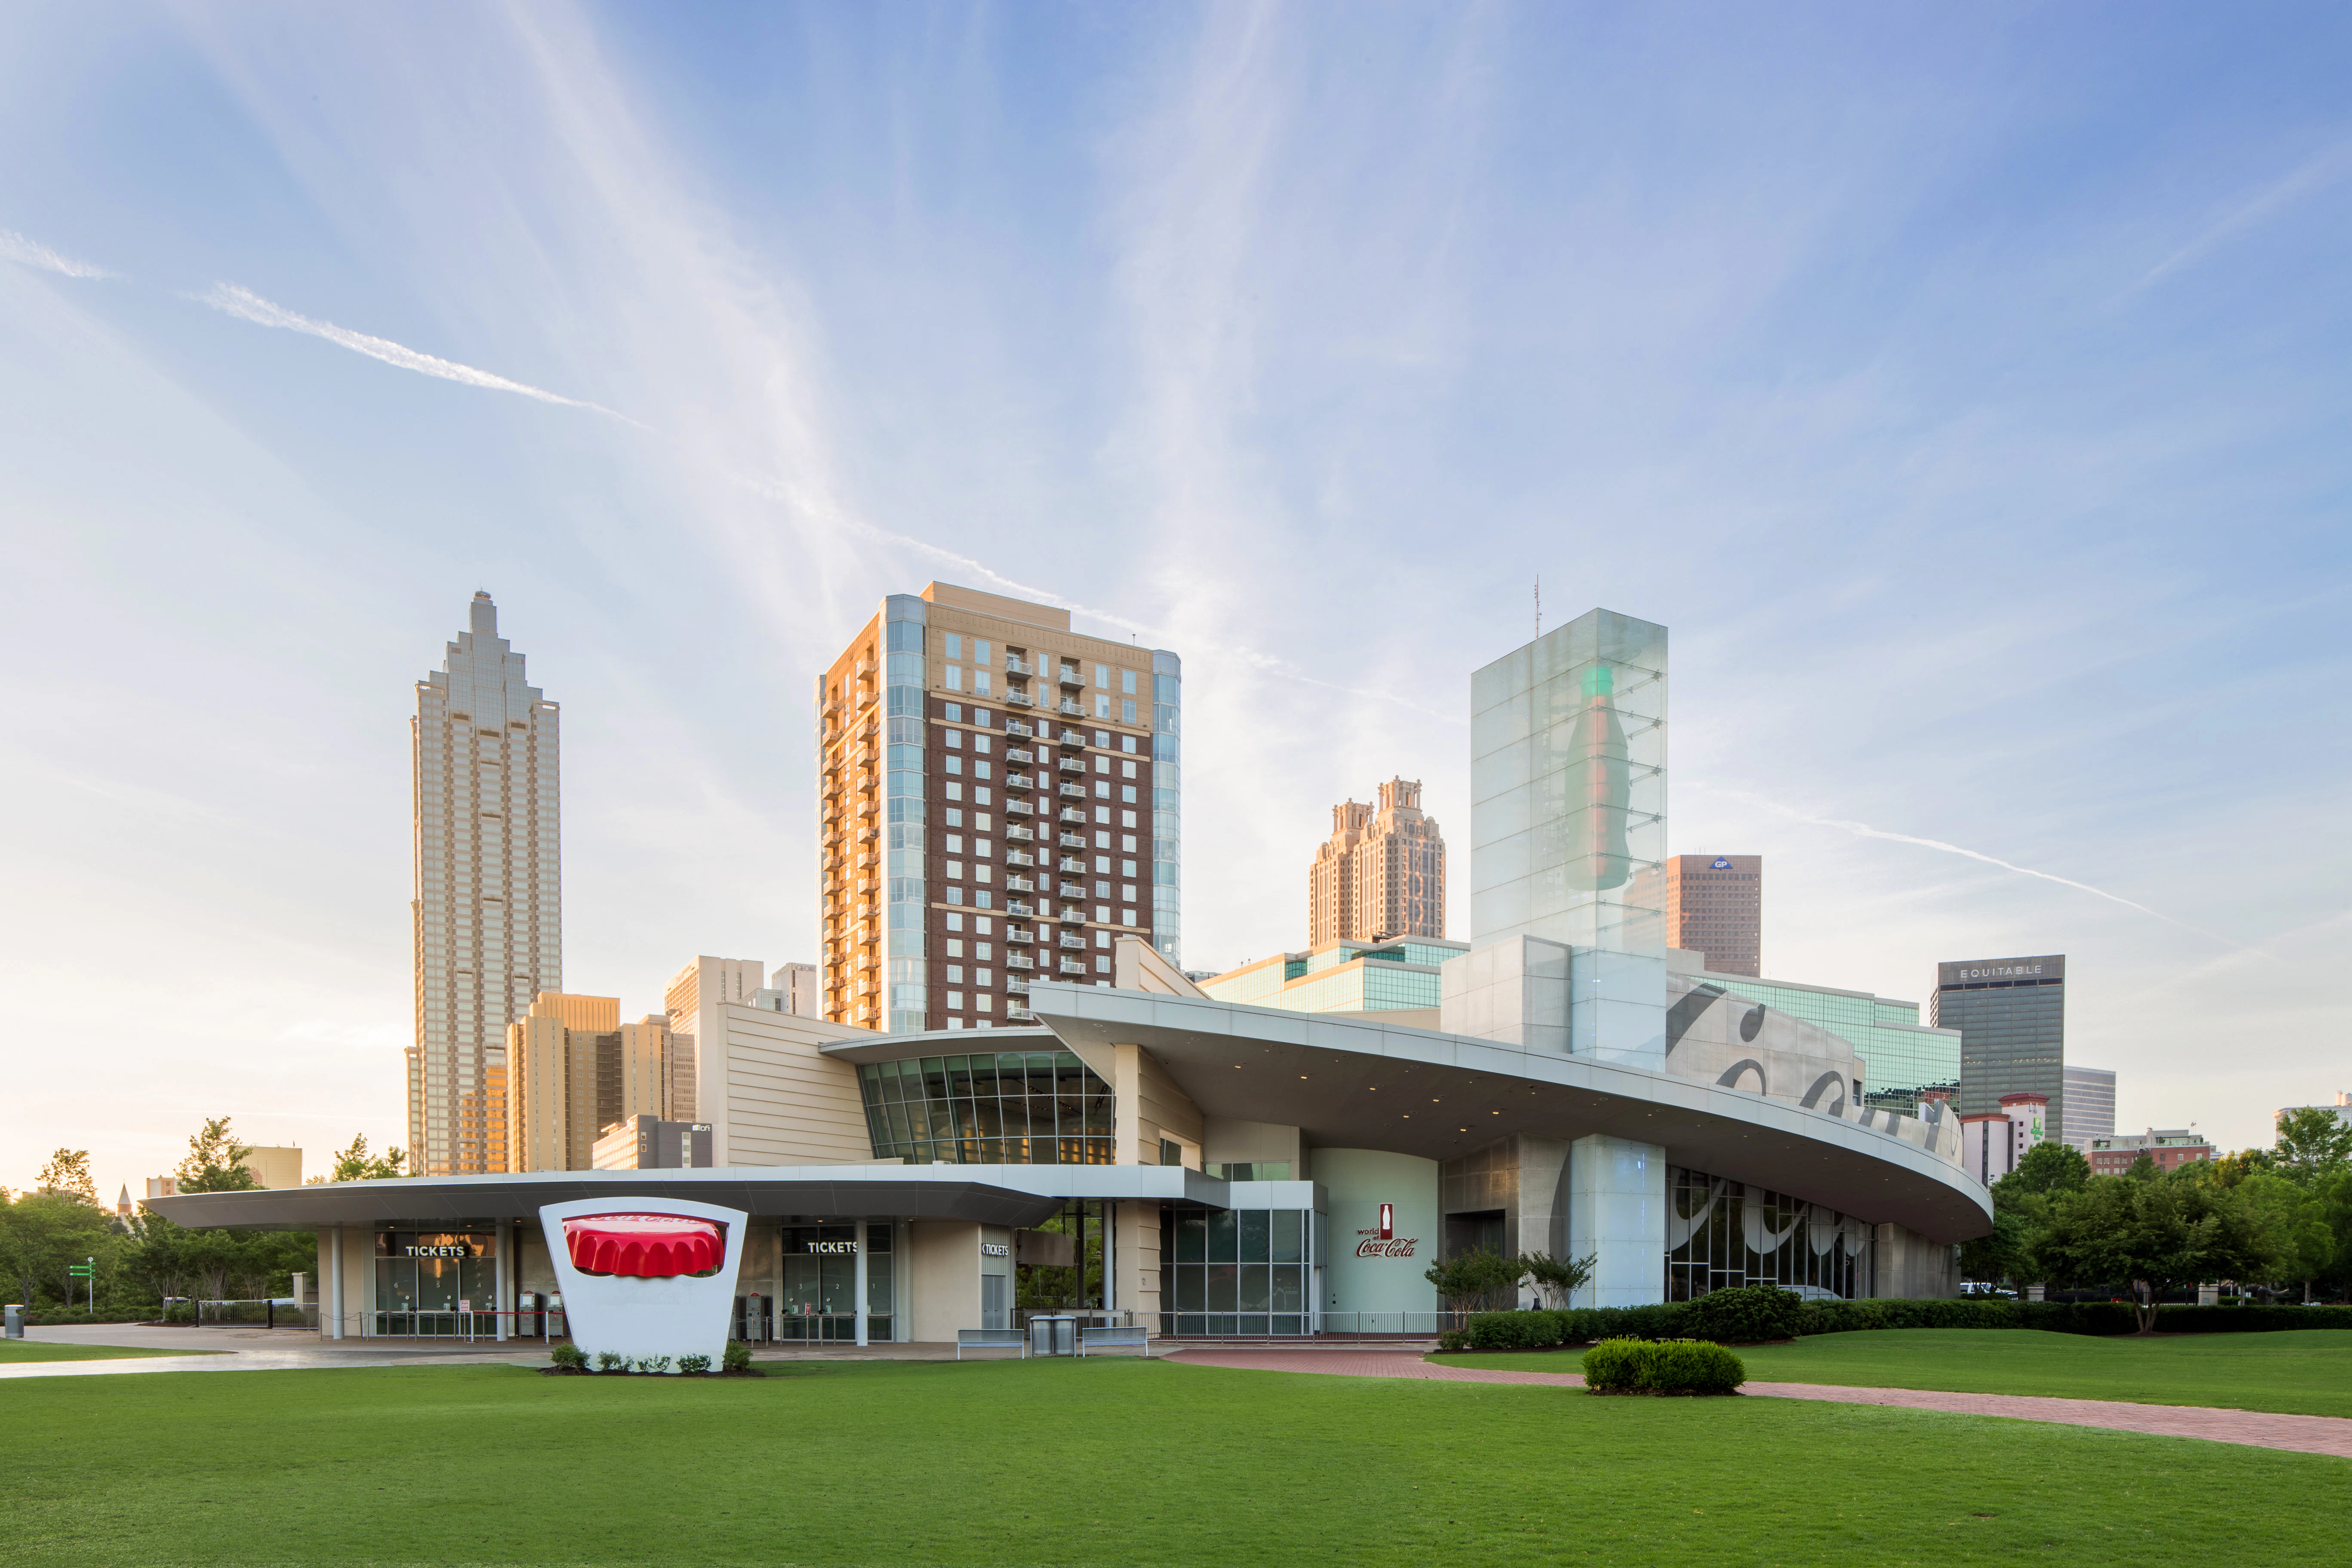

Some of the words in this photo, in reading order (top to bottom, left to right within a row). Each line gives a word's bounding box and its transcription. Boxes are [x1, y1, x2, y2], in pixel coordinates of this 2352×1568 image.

[1961, 965, 2041, 978] EQUITABLE
[406, 1246, 465, 1256] TICKETS
[808, 1241, 857, 1253] TICKETS
[985, 1244, 1008, 1256] TICKETS
[1356, 1238, 1418, 1257] Coca-Cola
